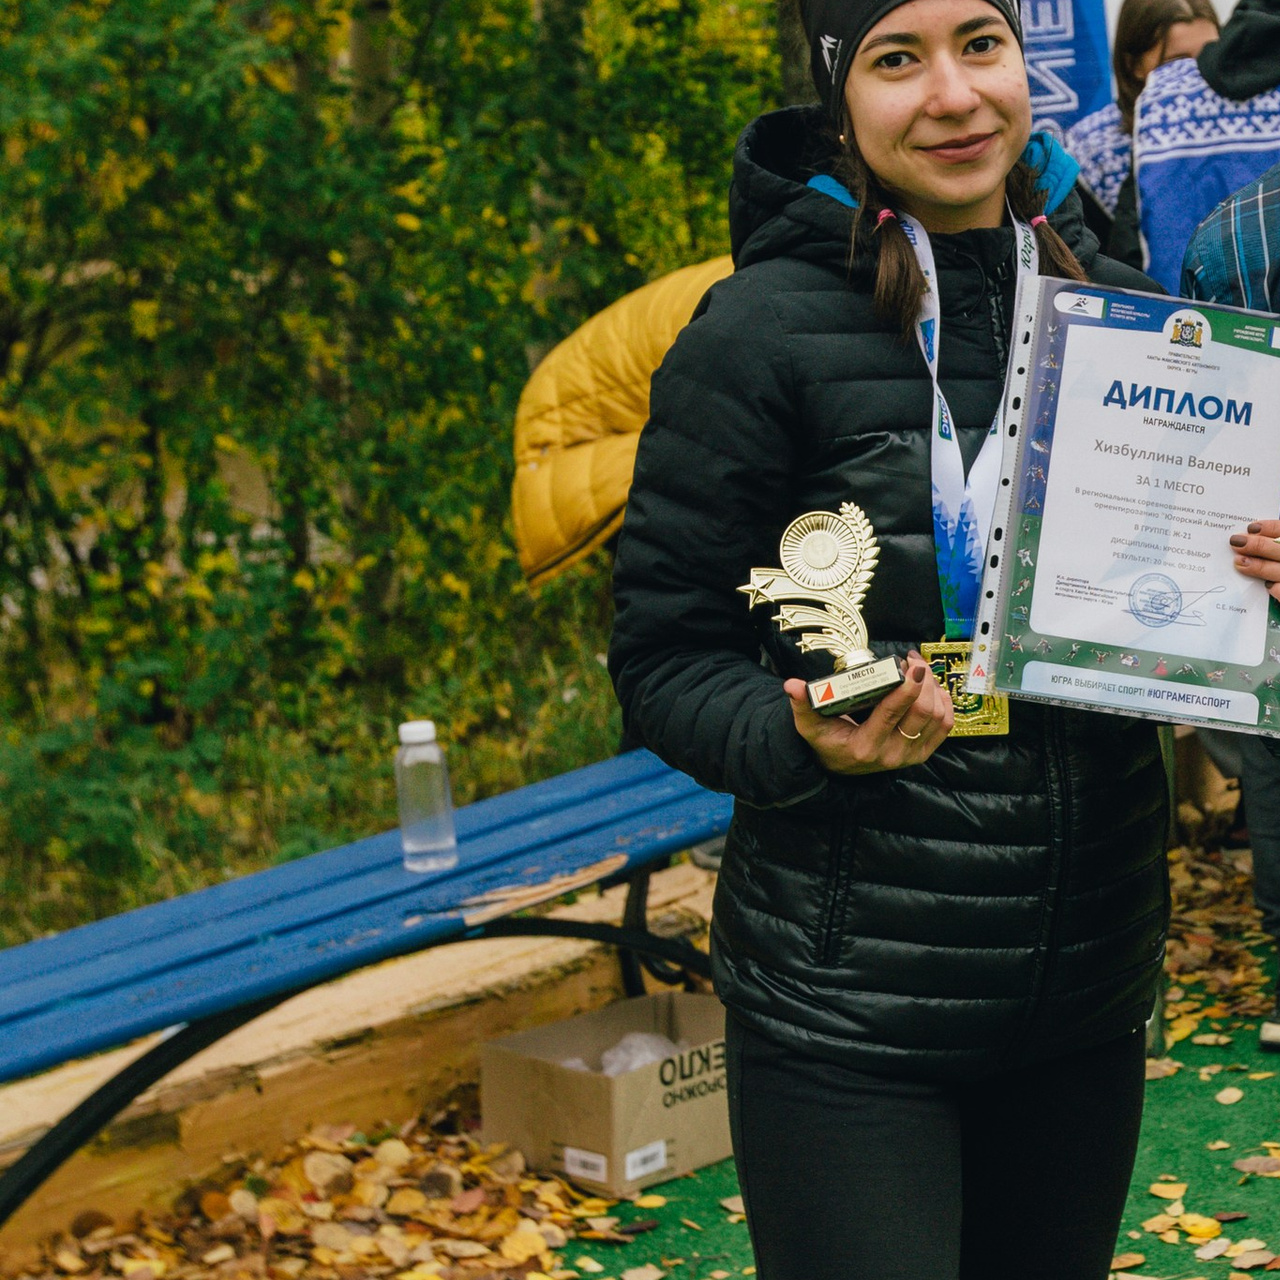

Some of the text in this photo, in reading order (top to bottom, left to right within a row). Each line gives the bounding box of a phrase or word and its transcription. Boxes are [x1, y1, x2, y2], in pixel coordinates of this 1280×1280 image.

[1103, 379, 1253, 426] ДИПЛОМ
[1143, 416, 1205, 434] НАГРАЖДАЕТСЯ
[1094, 439, 1251, 477] Хизбуллина Валерия
[1136, 475, 1205, 495] ЗА 1 МЕСТО
[1082, 488, 1136, 505] региональных
[1138, 497, 1195, 515] соревнованиях
[1196, 508, 1206, 516] по
[1094, 502, 1159, 519] ориентированию
[1141, 524, 1171, 536] ГРУППЕ:
[1173, 530, 1192, 540] Ж-21
[1110, 536, 1211, 560] ДИСЦИПЛИНА: КРОСС-ВЫБОР
[1112, 551, 1152, 565] РЕЗУЛЬТАТ:
[1153, 558, 1162, 566] 20
[851, 666, 875, 680] МЕСТО
[1051, 674, 1231, 709] ЮГРА ВЫБИРАЕТ СПОРТ! #ЮГРАМЕГАСПОРТ
[659, 1042, 726, 1086] ЕКЛО
